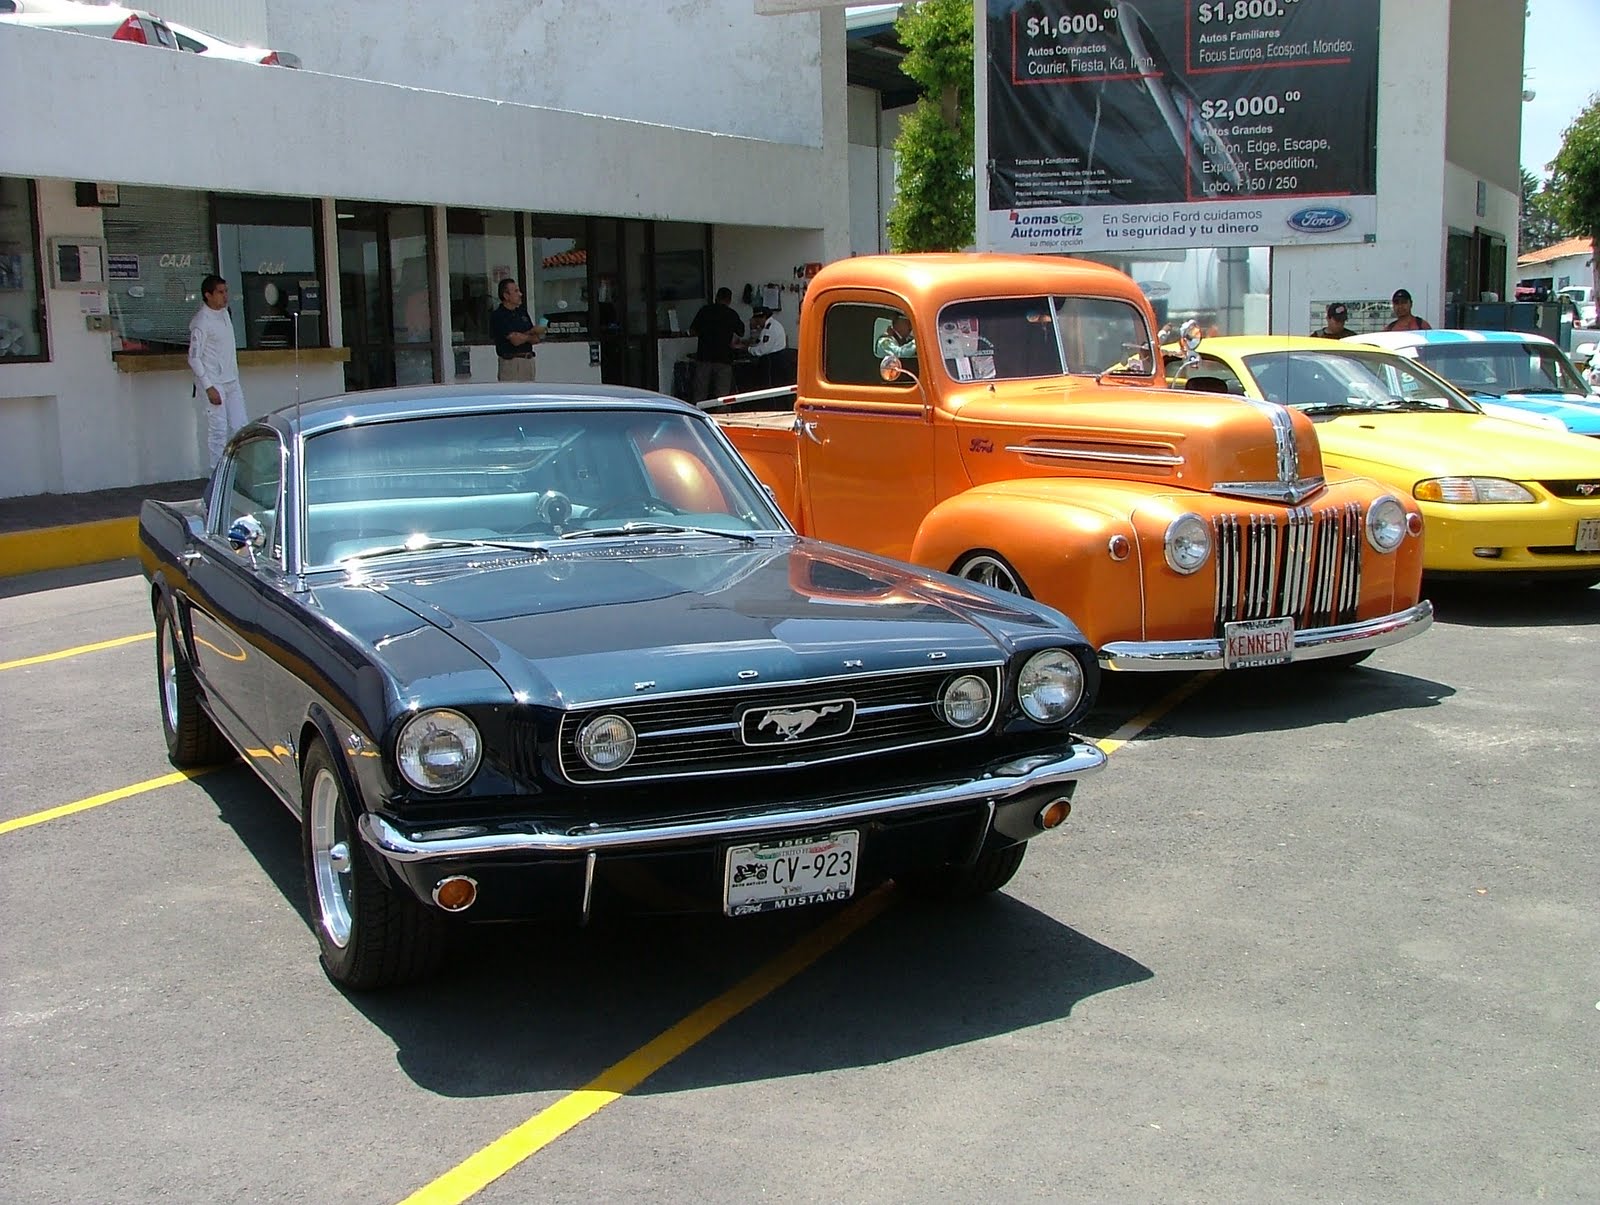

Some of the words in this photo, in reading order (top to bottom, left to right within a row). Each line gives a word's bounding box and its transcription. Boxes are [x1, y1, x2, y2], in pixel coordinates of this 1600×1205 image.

[1199, 0, 1299, 24] $1,800.
[1199, 33, 1228, 44] Autos
[1230, 29, 1281, 42] Familiares
[1027, 47, 1054, 57] Autos
[1055, 44, 1107, 57] Compactos
[1199, 49, 1227, 63] Focus
[1229, 46, 1265, 62] Europa,
[1267, 42, 1311, 59] Ecosport,
[1313, 38, 1355, 54] Mondeo.
[1028, 60, 1069, 76] Courier,
[1071, 58, 1107, 73] Fiesta,
[1110, 56, 1128, 71] Ka,
[1231, 125, 1274, 136] Grandes
[1203, 142, 1244, 155] Fuon,
[1247, 139, 1280, 155] Edge,
[1284, 137, 1331, 152] Escape,
[1255, 156, 1319, 173] Expedition,
[1202, 180, 1234, 193] Lobo,
[1275, 176, 1298, 190] 250
[1014, 213, 1060, 225] Lomas
[1102, 214, 1118, 225] En
[1121, 212, 1169, 224] Servicio
[1172, 211, 1201, 223] Ford
[1203, 209, 1263, 221] cuidamos
[1300, 210, 1337, 227] Ford
[1010, 225, 1083, 239] Automotriz
[1106, 228, 1118, 238] tu
[1122, 225, 1186, 239] seguridad
[1189, 227, 1197, 237] y
[1200, 225, 1213, 235] tu
[1217, 223, 1259, 234] dinero
[1039, 240, 1058, 248] mejor
[159, 254, 192, 268] CAJA
[969, 438, 994, 453] Ford
[1229, 631, 1290, 657] KENNEDY
[1236, 657, 1285, 669] PICKUP
[772, 850, 852, 885] CV-923
[774, 890, 846, 909] MUSTANG
